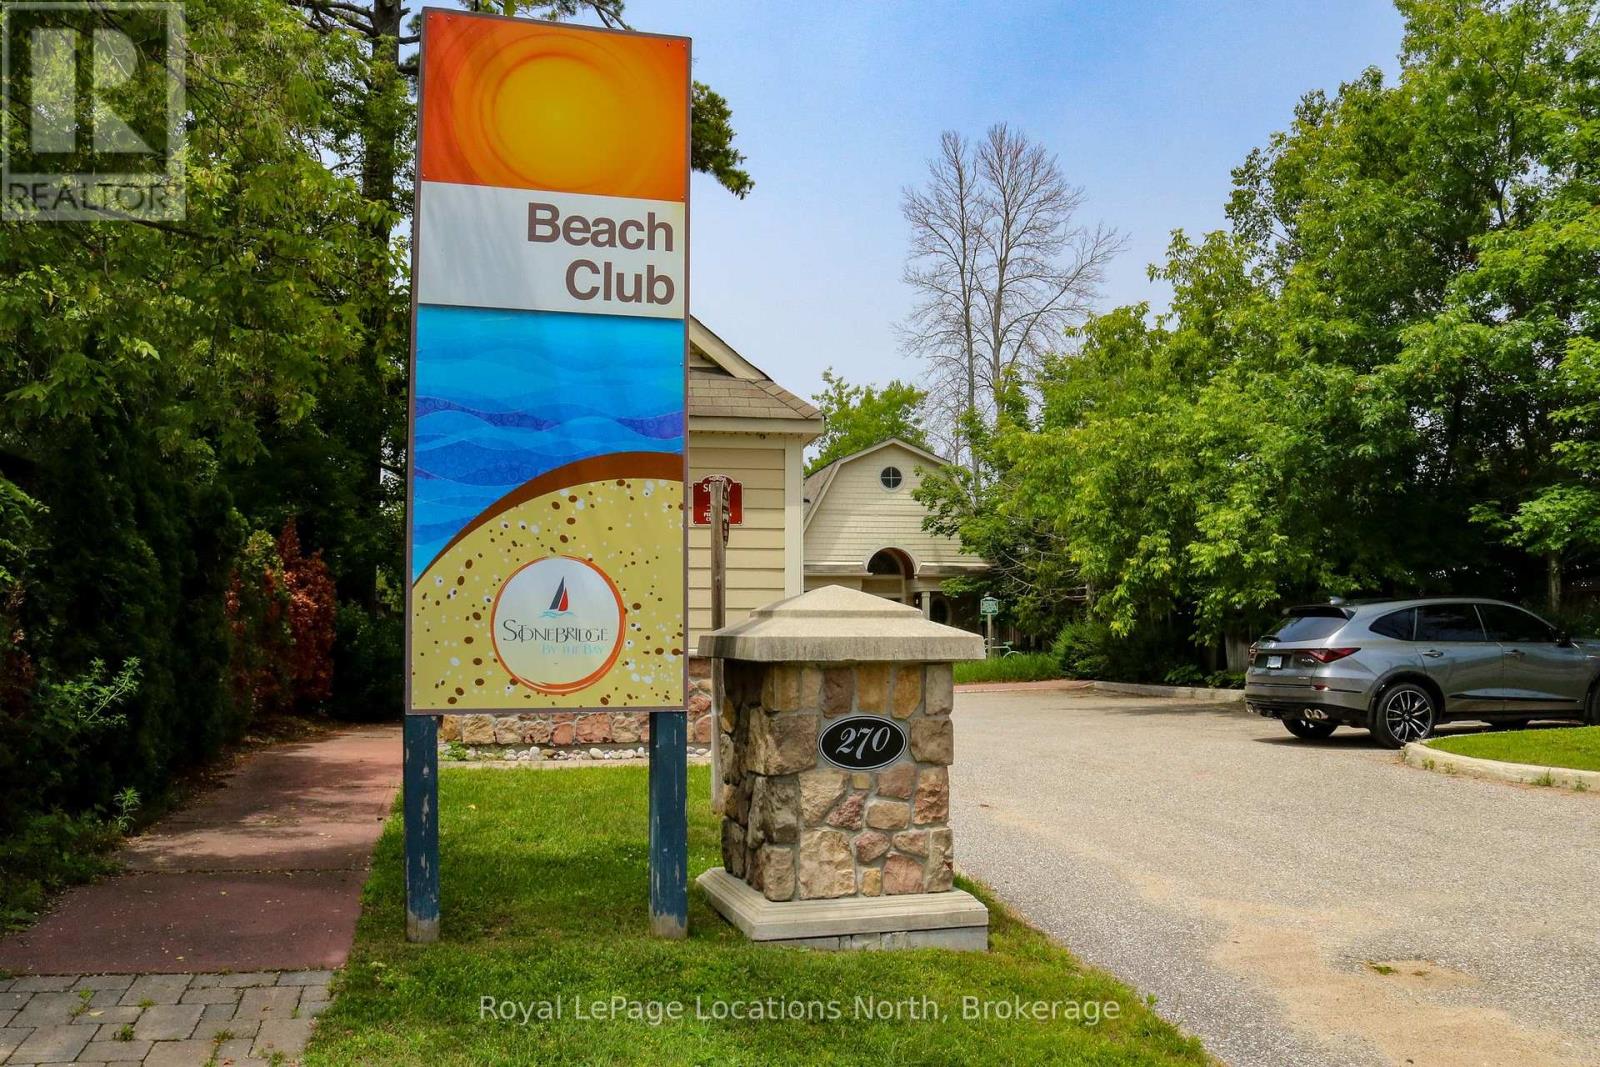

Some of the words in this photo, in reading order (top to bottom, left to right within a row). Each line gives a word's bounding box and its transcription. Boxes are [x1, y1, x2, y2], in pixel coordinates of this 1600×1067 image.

[528, 202, 674, 252] Beach
[565, 258, 675, 306] Club
[835, 726, 891, 760] 270
